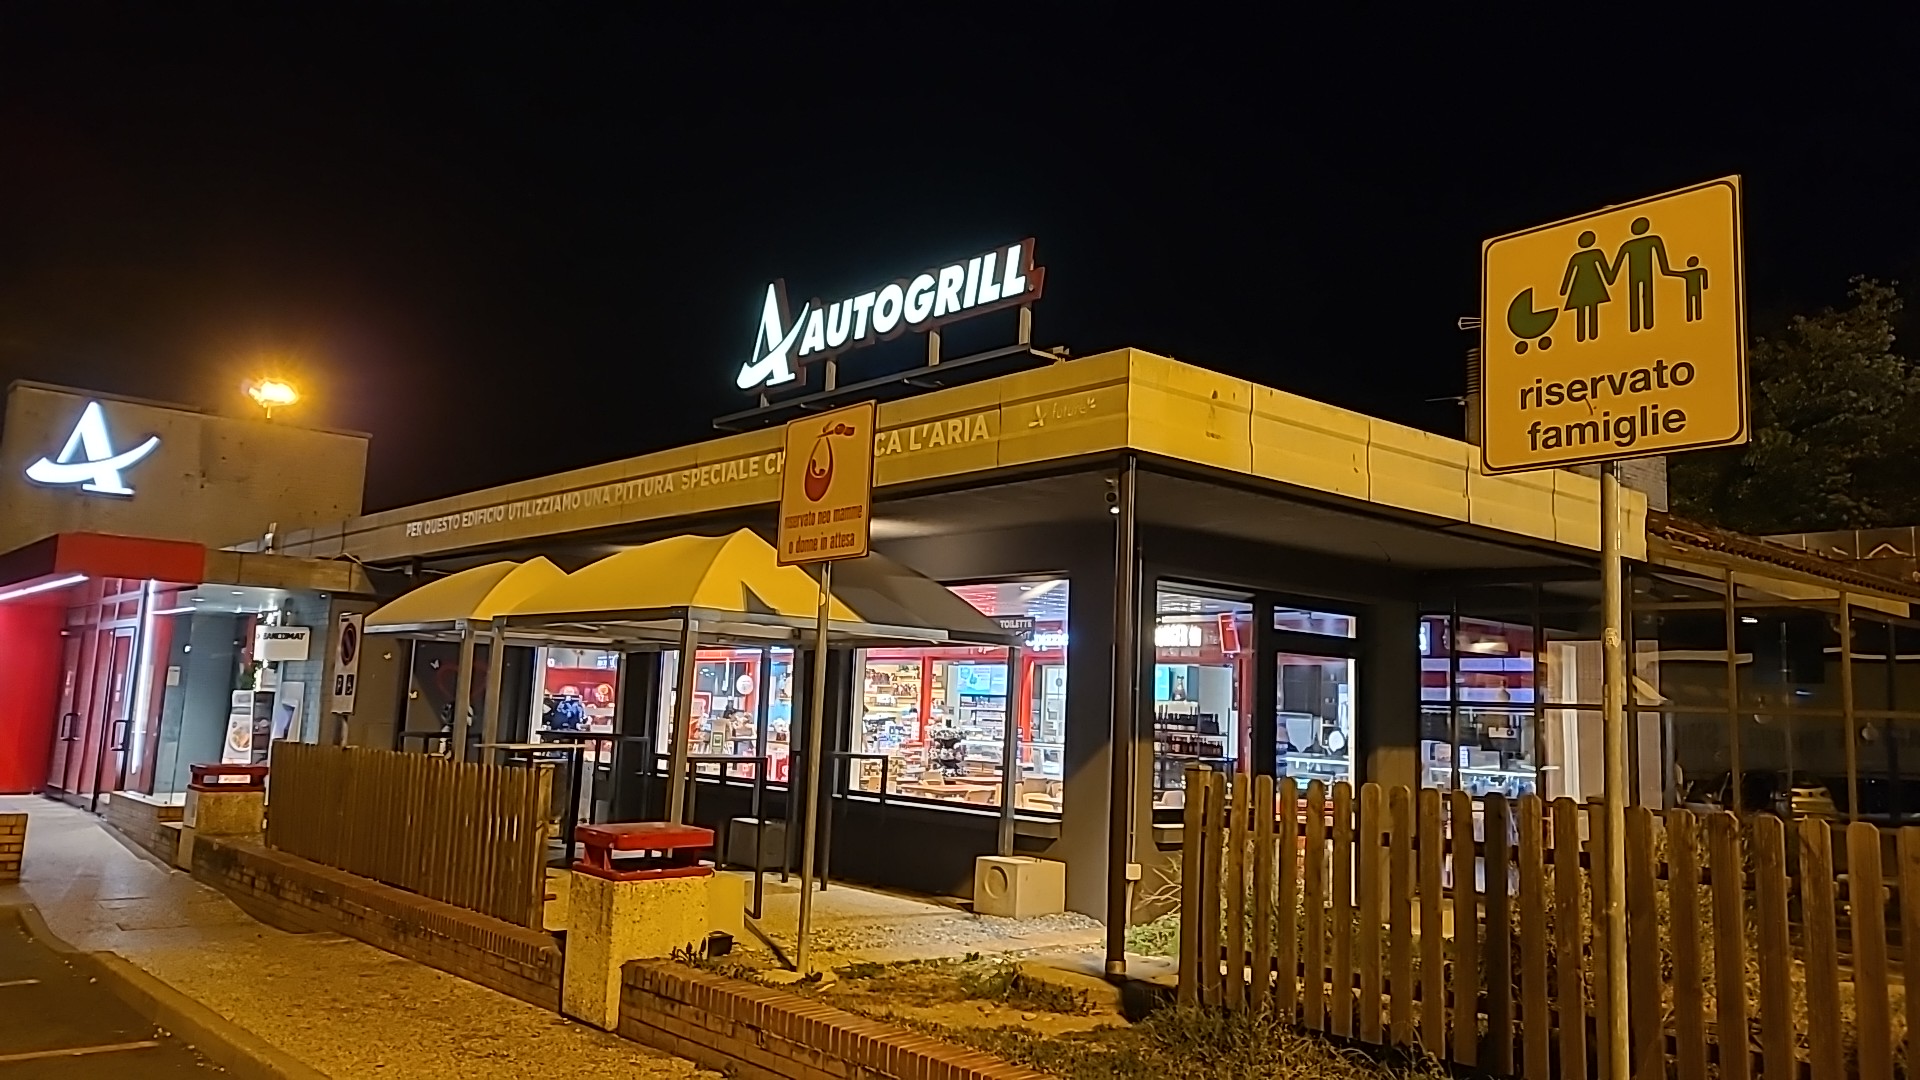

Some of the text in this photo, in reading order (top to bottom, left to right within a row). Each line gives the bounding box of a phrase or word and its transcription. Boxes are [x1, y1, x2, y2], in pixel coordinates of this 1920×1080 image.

[799, 244, 1026, 356] AUTOGRILL
[1520, 360, 1695, 410] riservato
[1527, 404, 1687, 451] famiglie
[405, 415, 989, 538] PER QUESTO EDIFICIO UTILIZZIAMO UNA PITTURA SPECIALE CH CA L'ARIA
[785, 505, 863, 529] riservato neo mamme
[796, 535, 818, 553] donne
[820, 532, 828, 550] in
[830, 532, 855, 549] attesa
[999, 619, 1032, 629] TOILETTE
